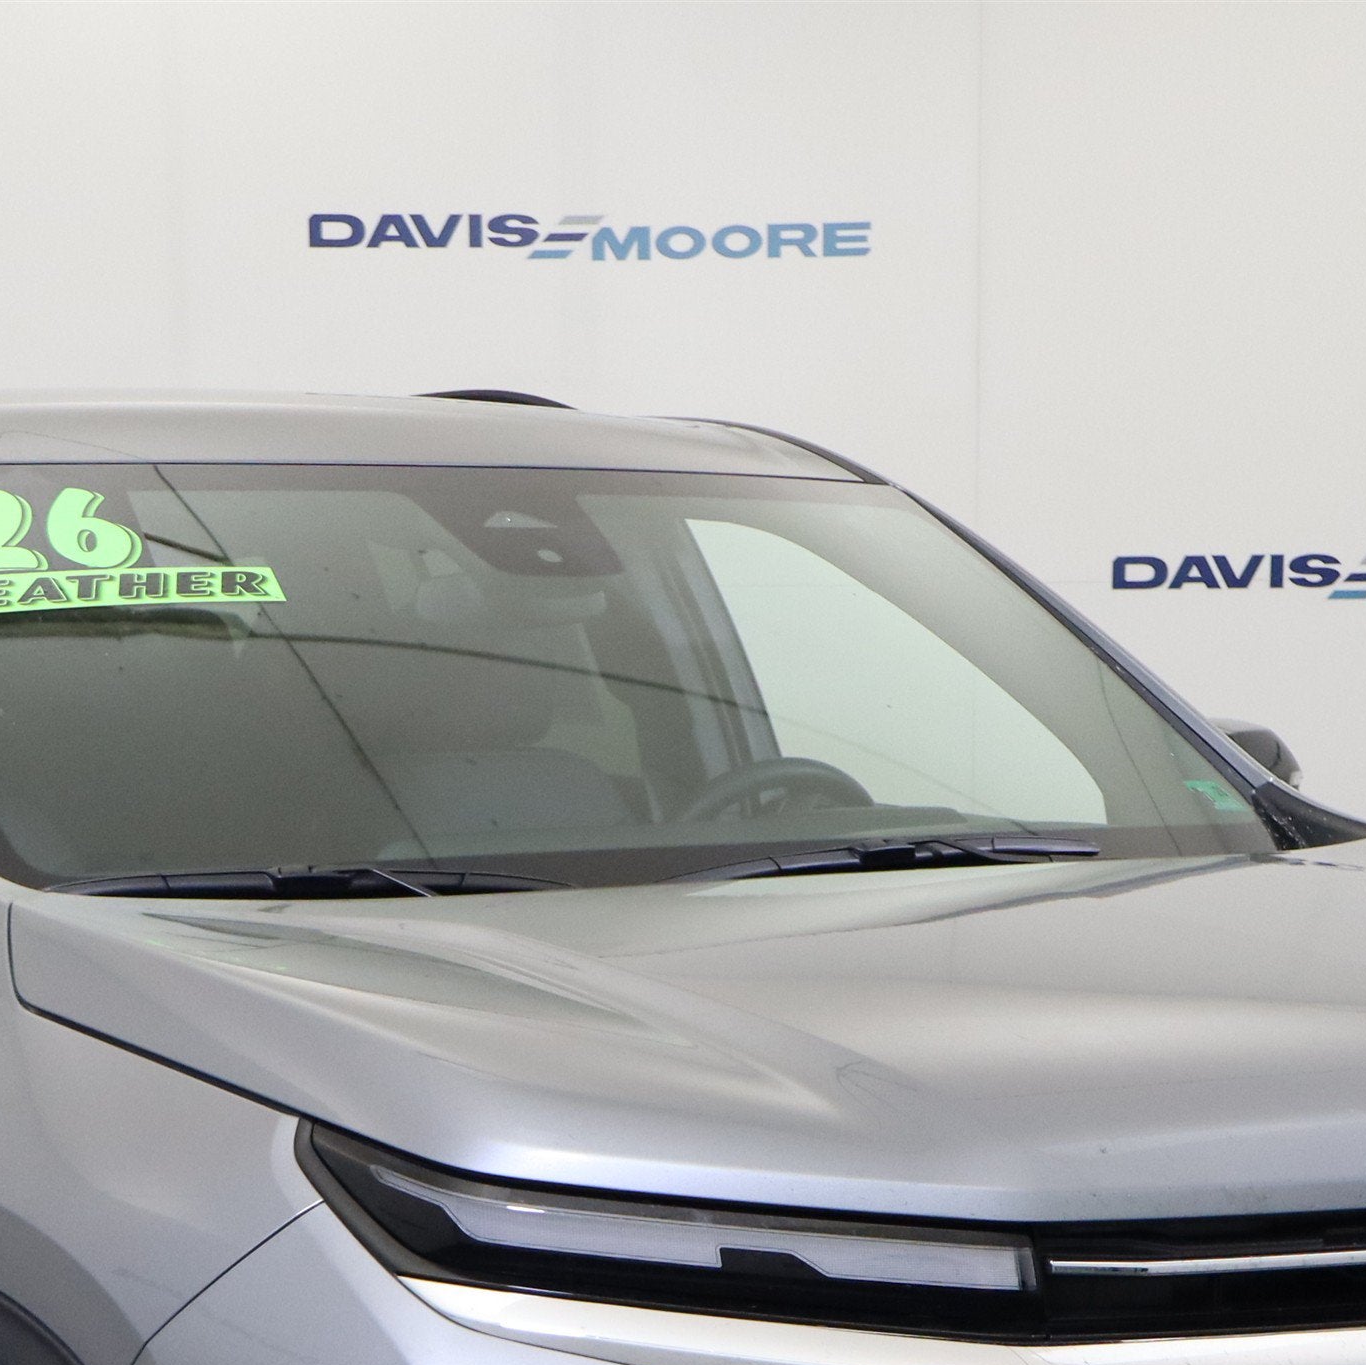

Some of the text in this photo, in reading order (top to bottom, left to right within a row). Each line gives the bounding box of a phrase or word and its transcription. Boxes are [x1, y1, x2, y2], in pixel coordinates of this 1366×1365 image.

[308, 213, 872, 260] DAVIS MOORE
[1112, 553, 1341, 590] DAVIS
